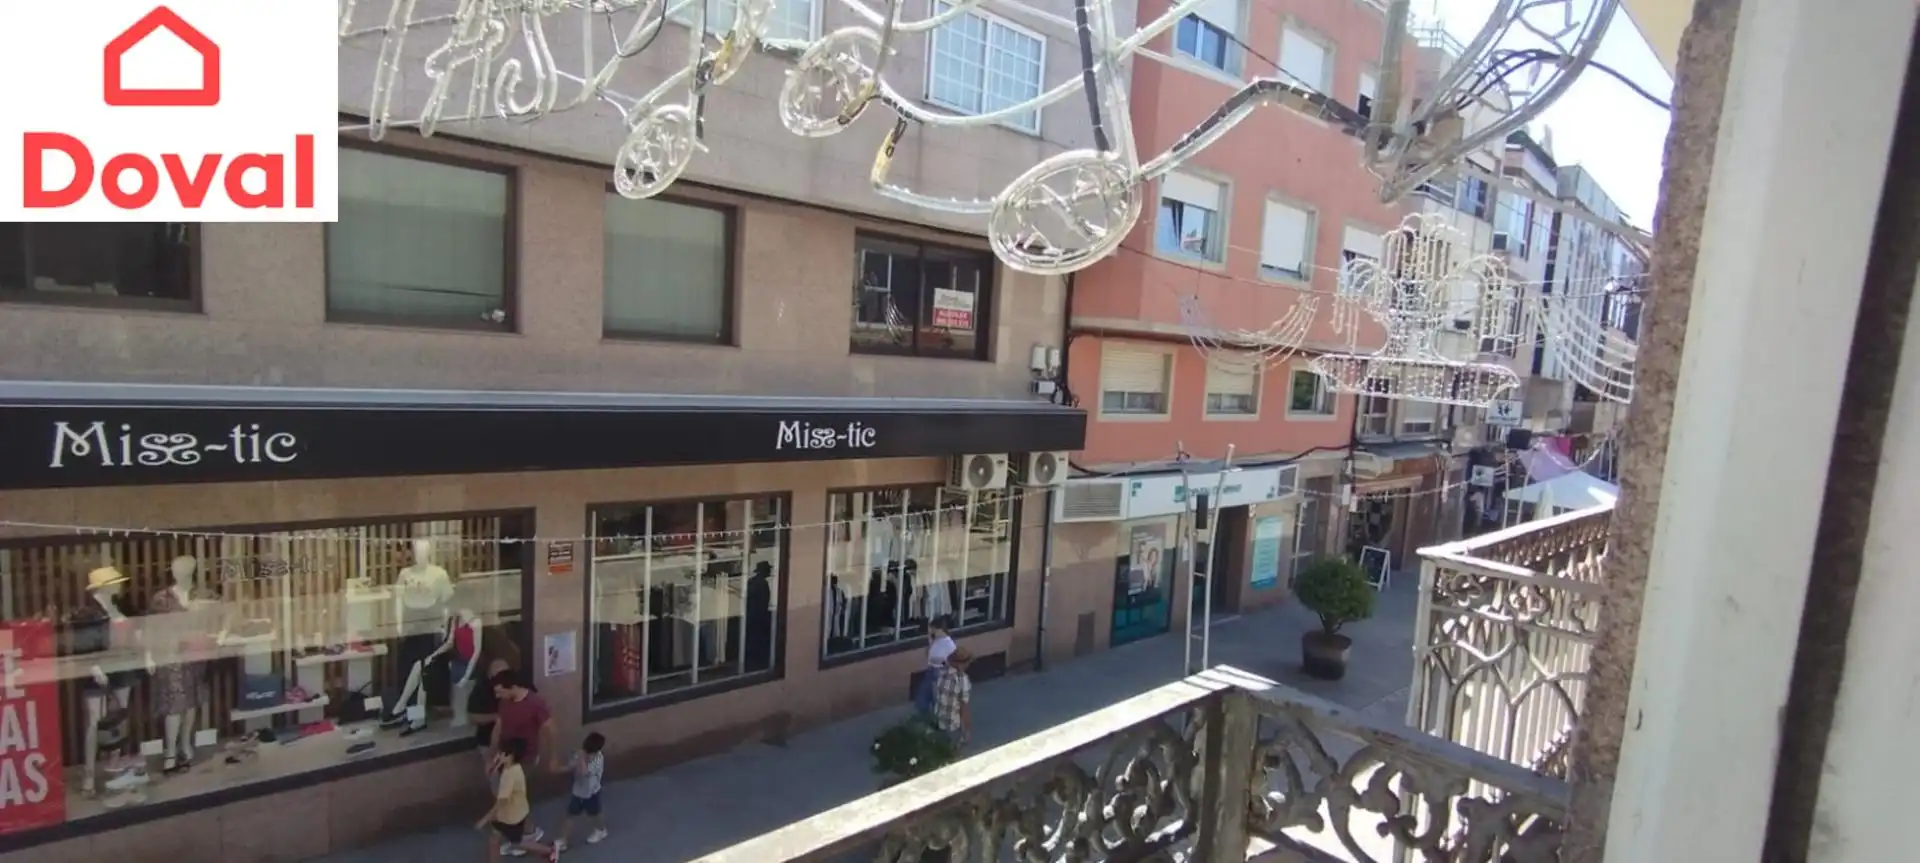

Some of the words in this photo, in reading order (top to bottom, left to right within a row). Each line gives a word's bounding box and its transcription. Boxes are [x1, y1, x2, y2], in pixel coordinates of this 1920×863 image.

[48, 420, 298, 468] Miss-tic
[775, 420, 876, 450] Miss-tic
[0, 647, 25, 699] E
